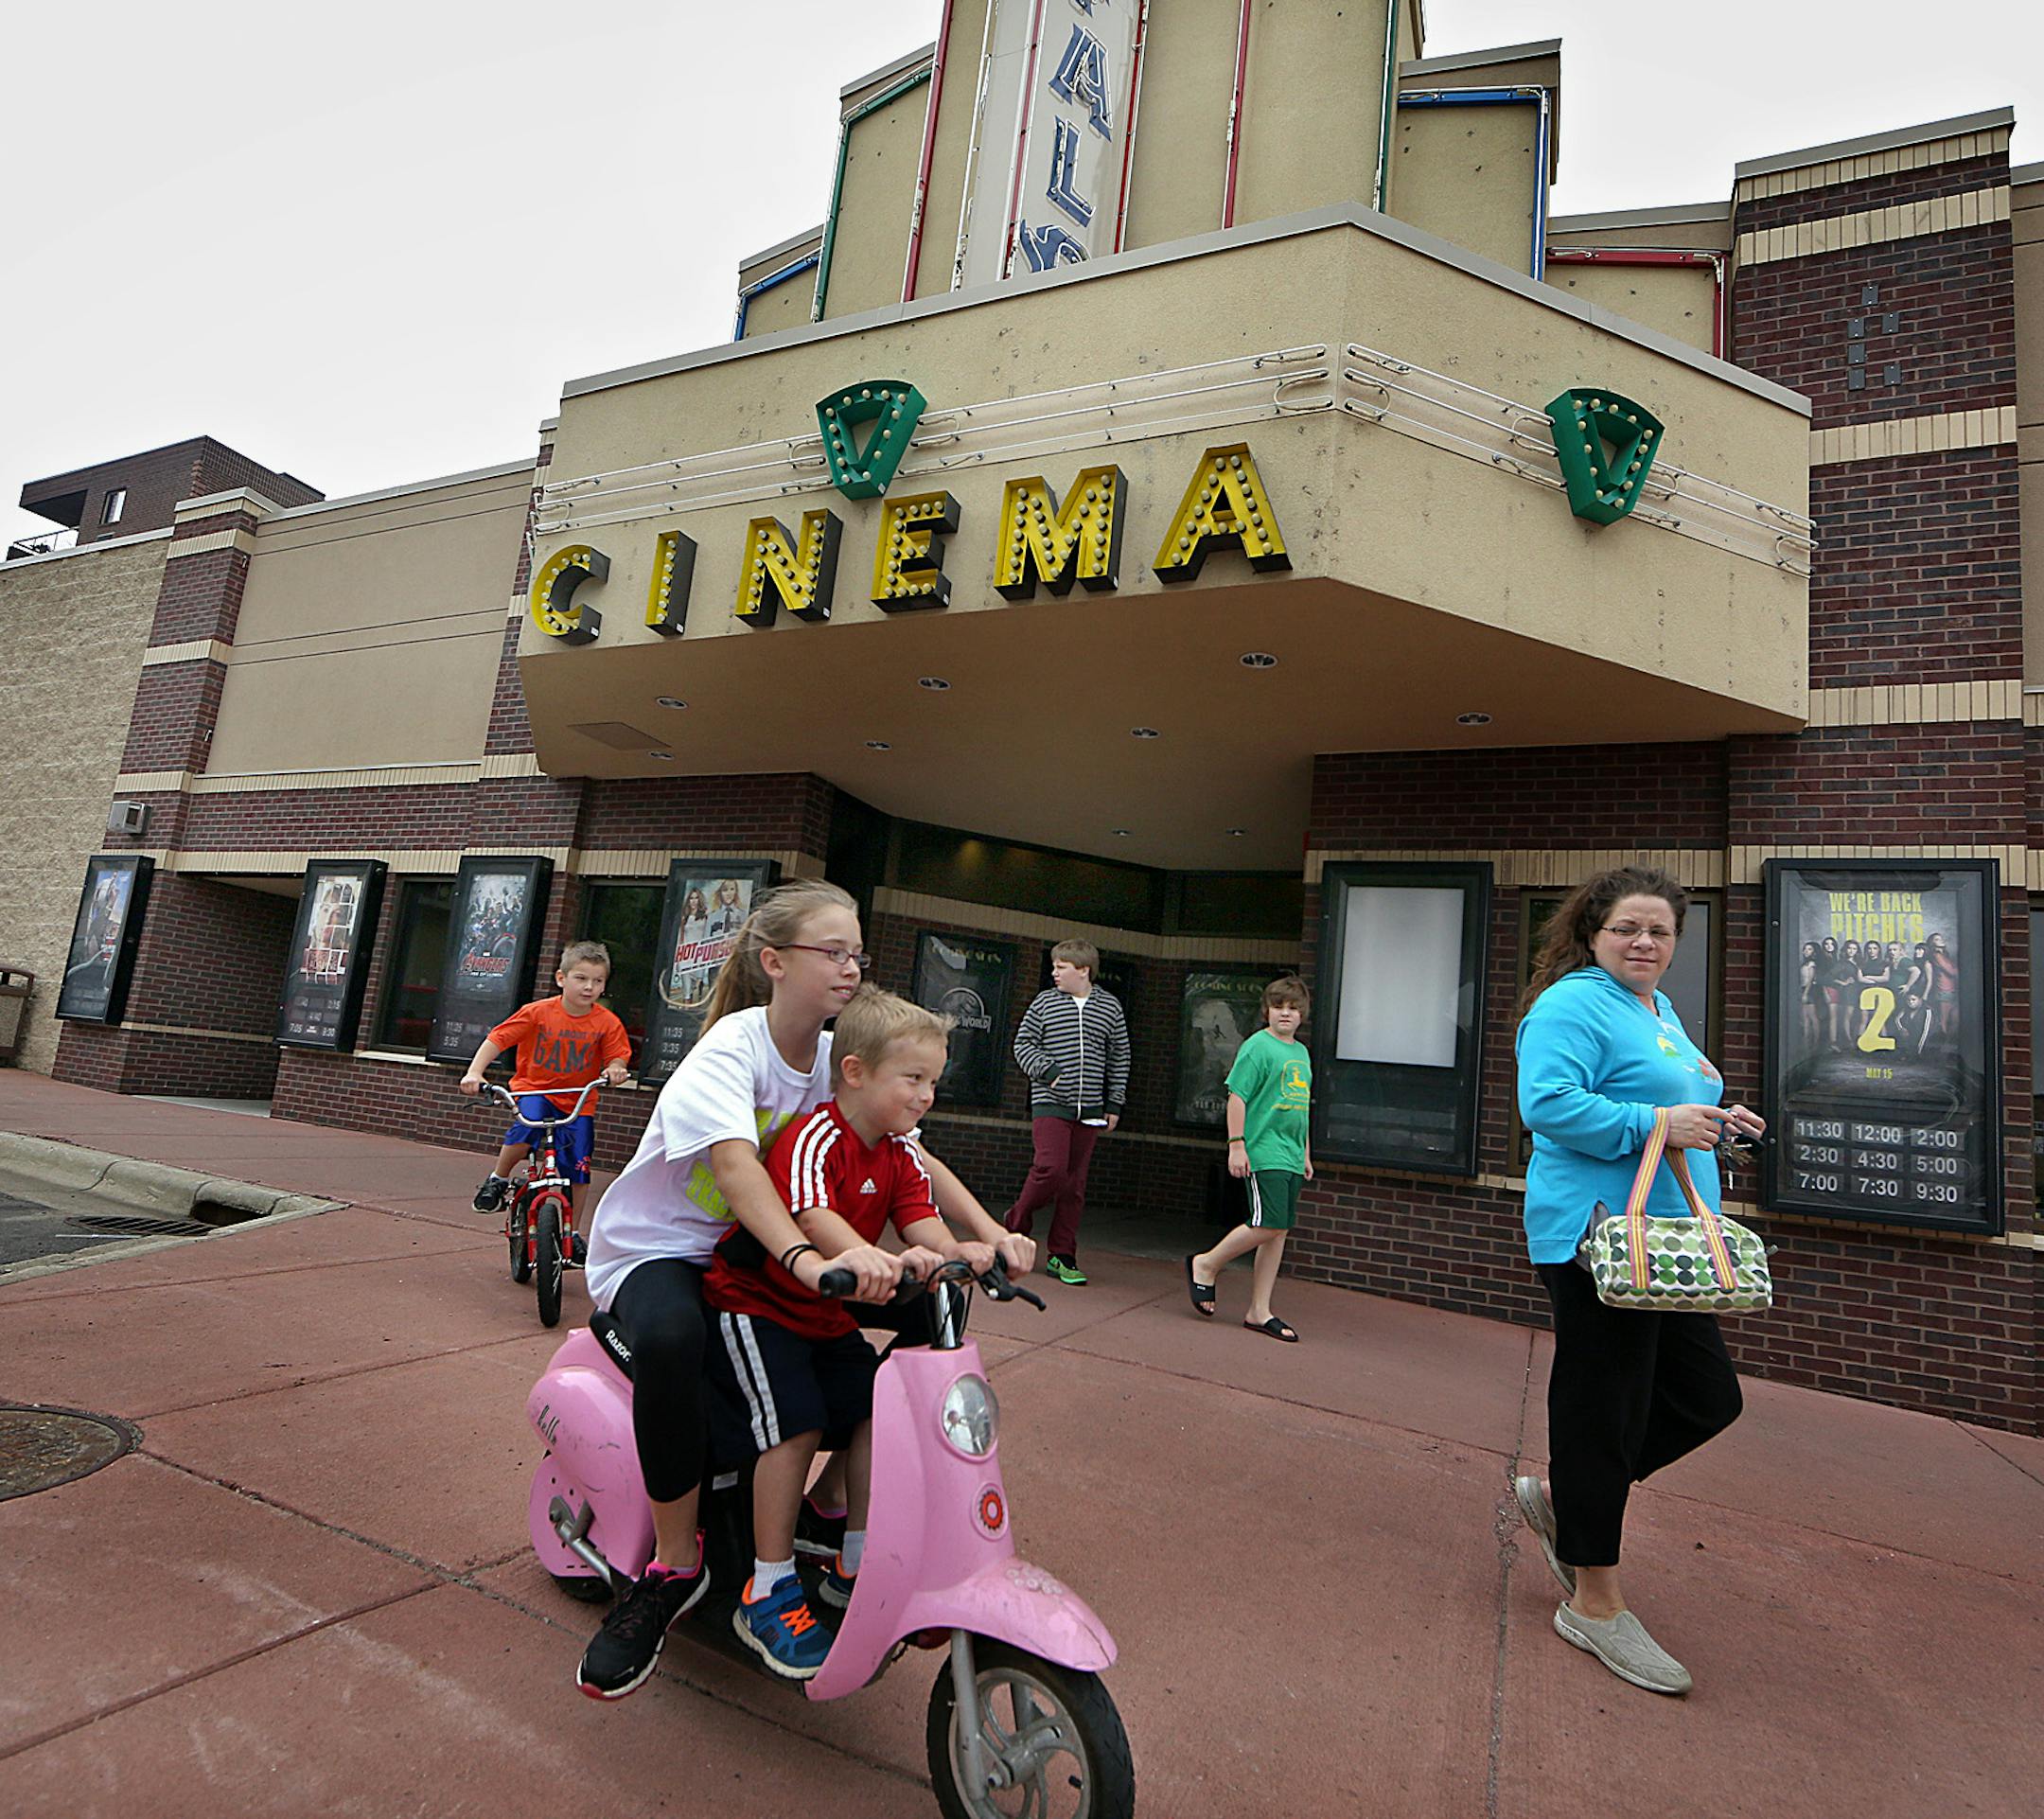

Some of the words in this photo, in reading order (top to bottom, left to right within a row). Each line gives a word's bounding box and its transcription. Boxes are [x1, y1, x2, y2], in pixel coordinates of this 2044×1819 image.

[529, 441, 1294, 645] CINEMA
[1829, 892, 1875, 912] WE'RE
[1880, 892, 1923, 912] BACK
[1830, 913, 1924, 944] PITCHES
[675, 942, 697, 963] HOT
[663, 1026, 683, 1038] 11:35
[1858, 987, 1895, 1052] 2
[1865, 1067, 1880, 1079] MAY
[1797, 1121, 1842, 1139] 11:30
[1856, 1123, 1901, 1144] 12:00
[1916, 1129, 1958, 1148] 2:00
[1799, 1144, 1839, 1164] 2:30
[1858, 1151, 1898, 1170] 4:30
[1916, 1157, 1957, 1174] 5:00
[1799, 1173, 1838, 1192] 7:00
[1858, 1177, 1898, 1197] 7:30
[1915, 1182, 1958, 1203] 9:30
